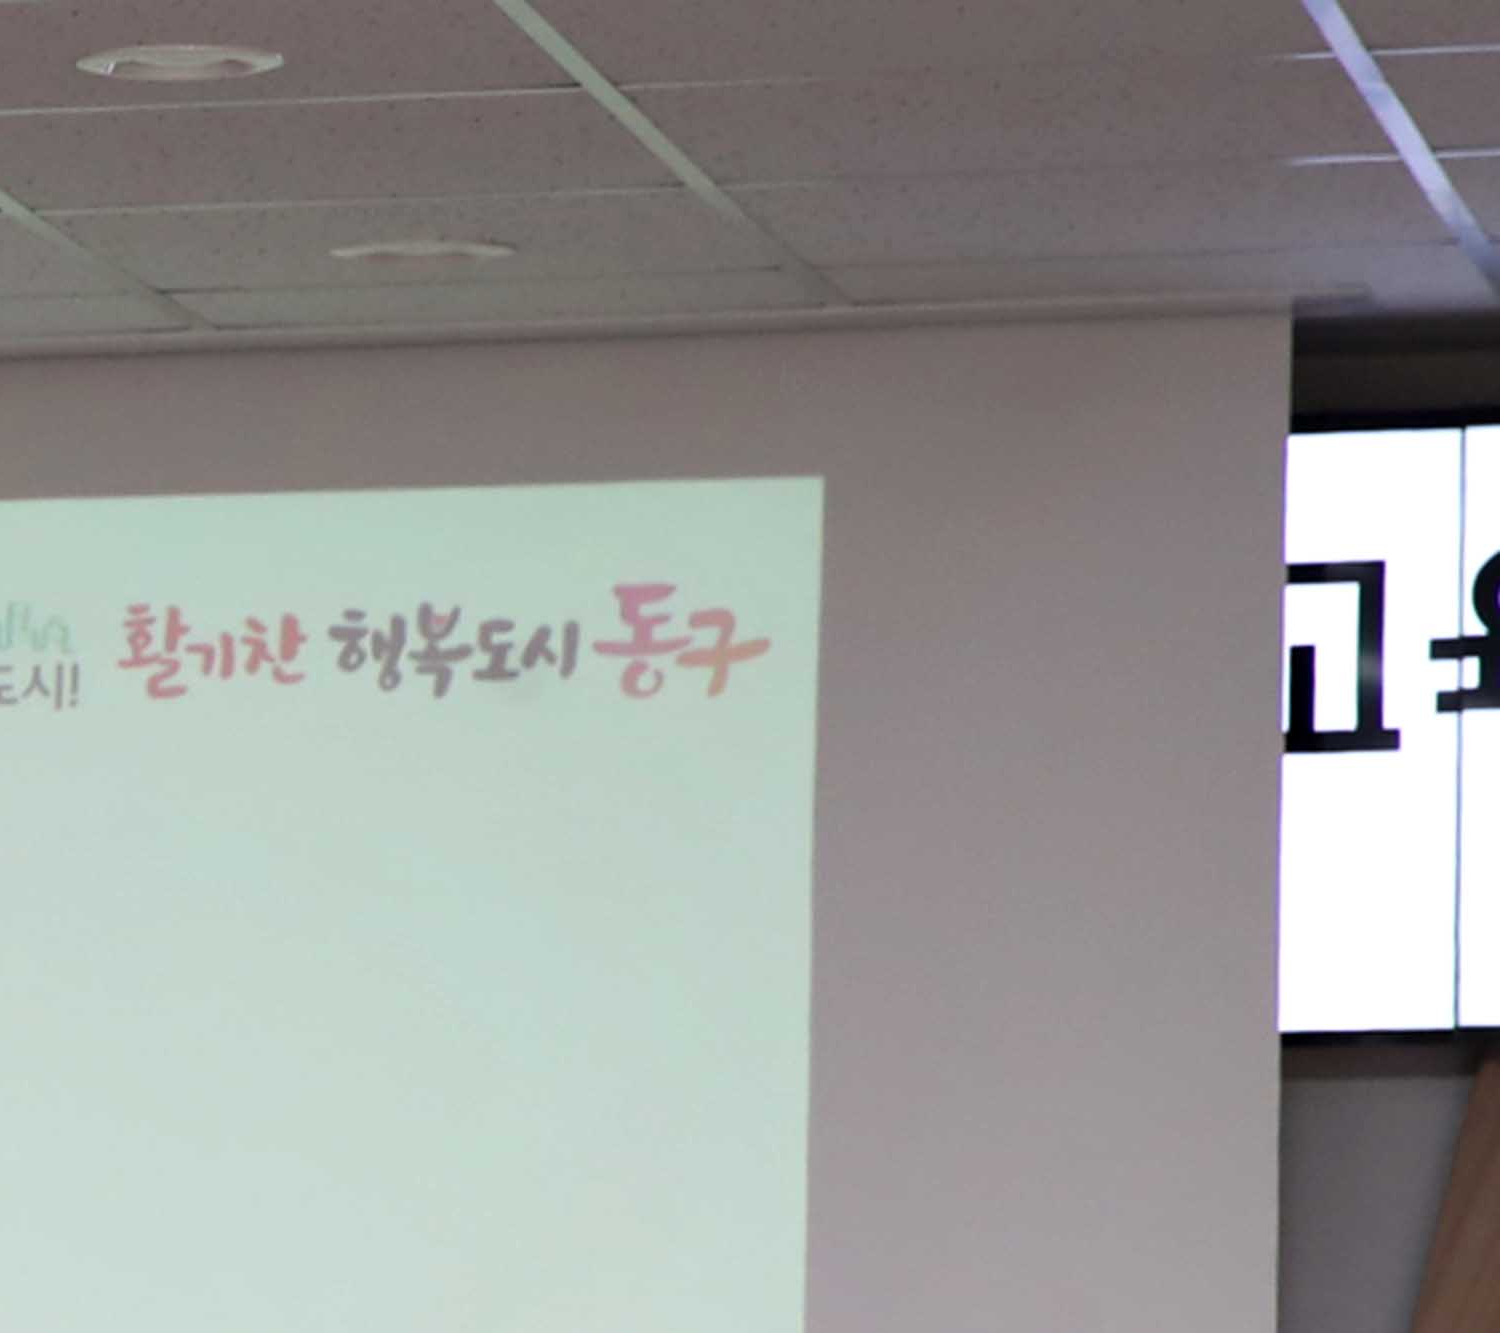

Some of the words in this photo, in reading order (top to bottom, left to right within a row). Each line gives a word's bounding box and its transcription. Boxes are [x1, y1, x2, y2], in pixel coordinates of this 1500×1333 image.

[118, 603, 308, 700] 활기찬
[327, 602, 580, 699] 행복도시
[593, 584, 772, 698] 동구
